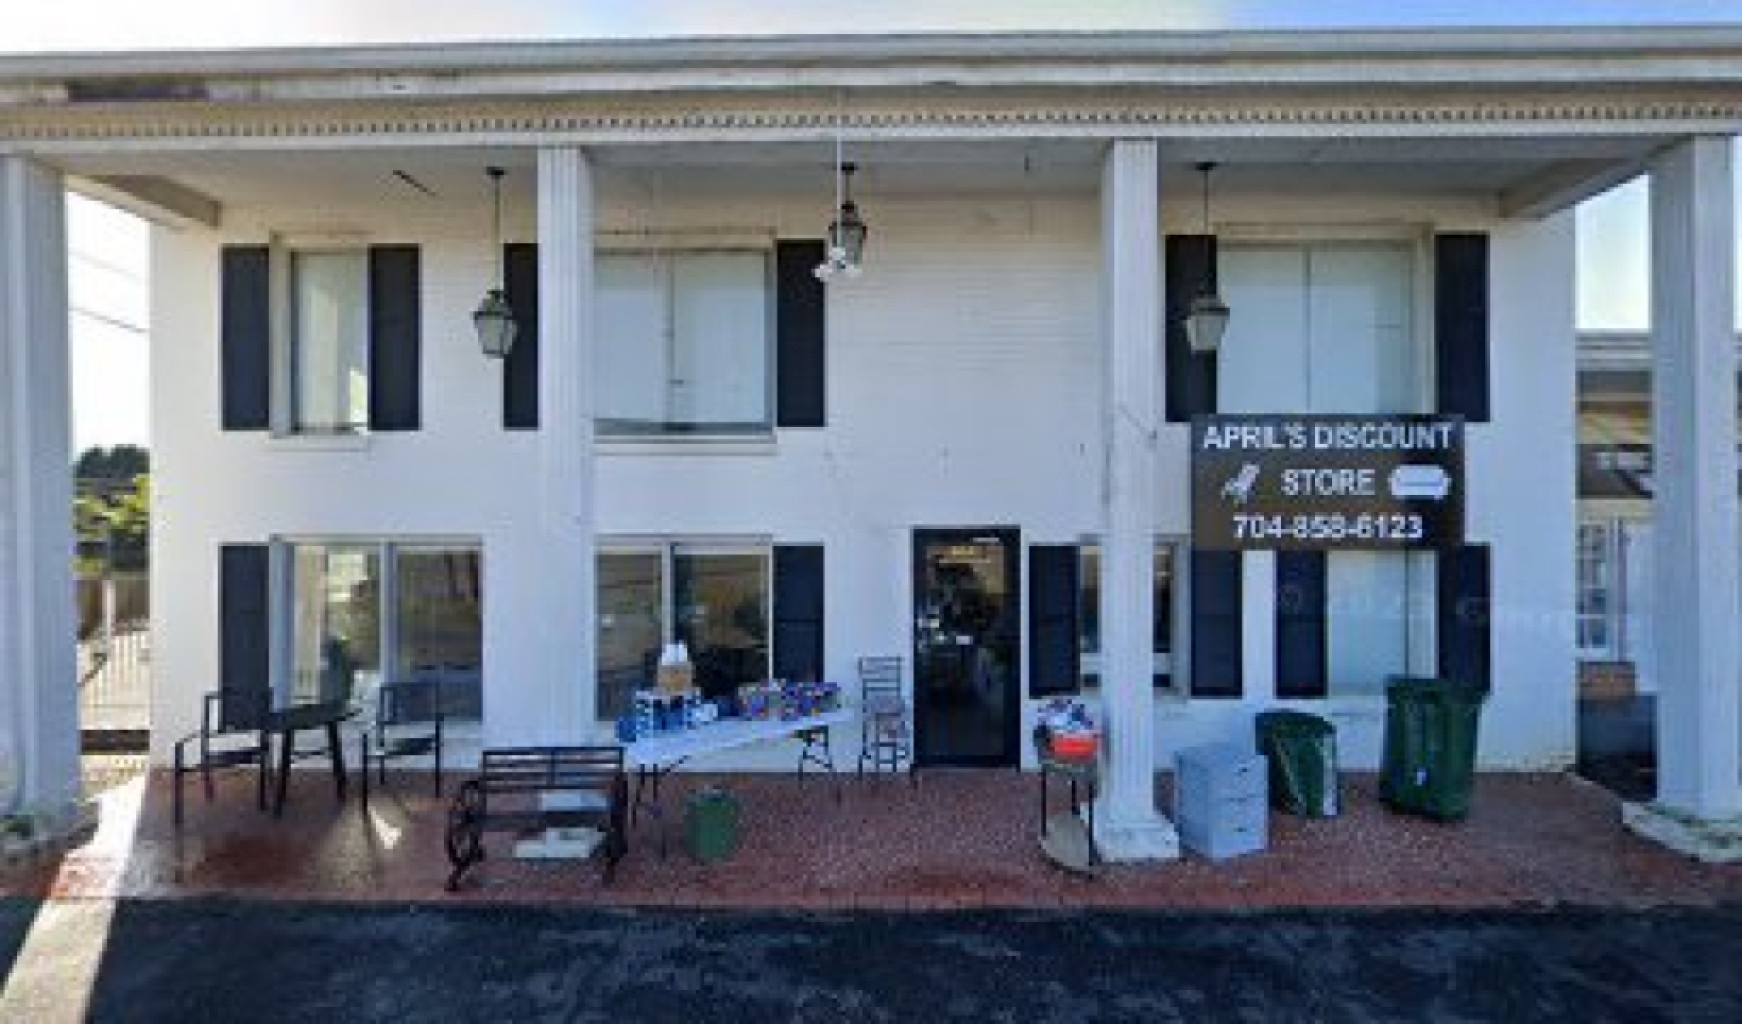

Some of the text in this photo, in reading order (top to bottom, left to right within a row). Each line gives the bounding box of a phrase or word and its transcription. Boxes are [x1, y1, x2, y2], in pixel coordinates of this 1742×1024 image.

[1203, 422, 1453, 448] APRIL'S DISCOUNT
[1281, 468, 1376, 496] STORE
